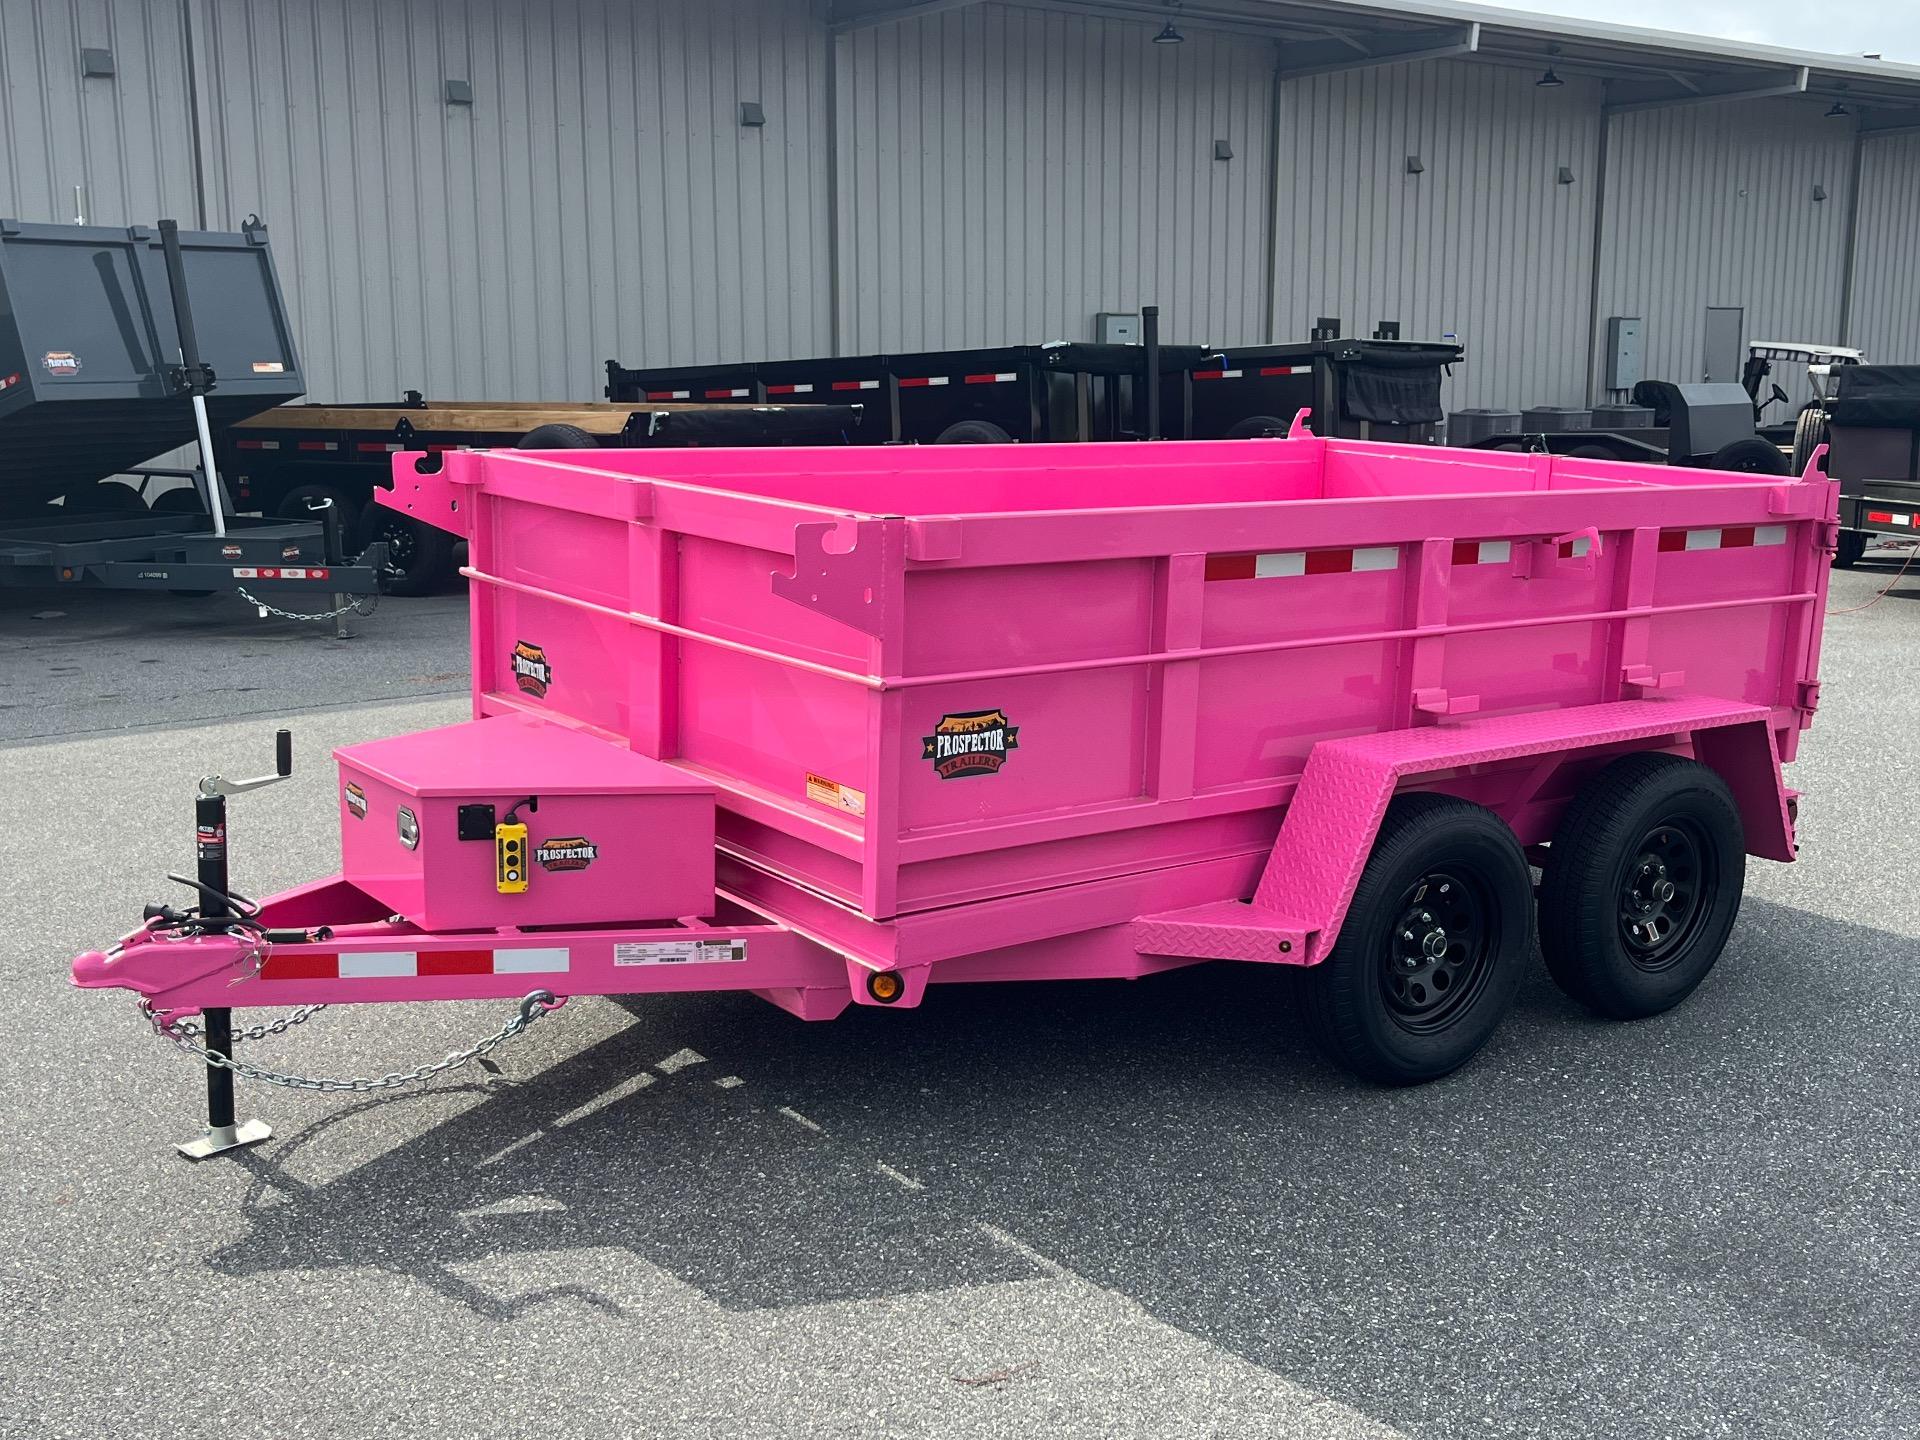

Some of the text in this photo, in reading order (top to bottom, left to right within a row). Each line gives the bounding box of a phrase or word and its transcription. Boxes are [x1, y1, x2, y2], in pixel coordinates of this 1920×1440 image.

[937, 728, 1004, 758] PROSPECTOR
[943, 754, 998, 774] TRAILERS
[537, 847, 595, 861] PROSPECTOR
